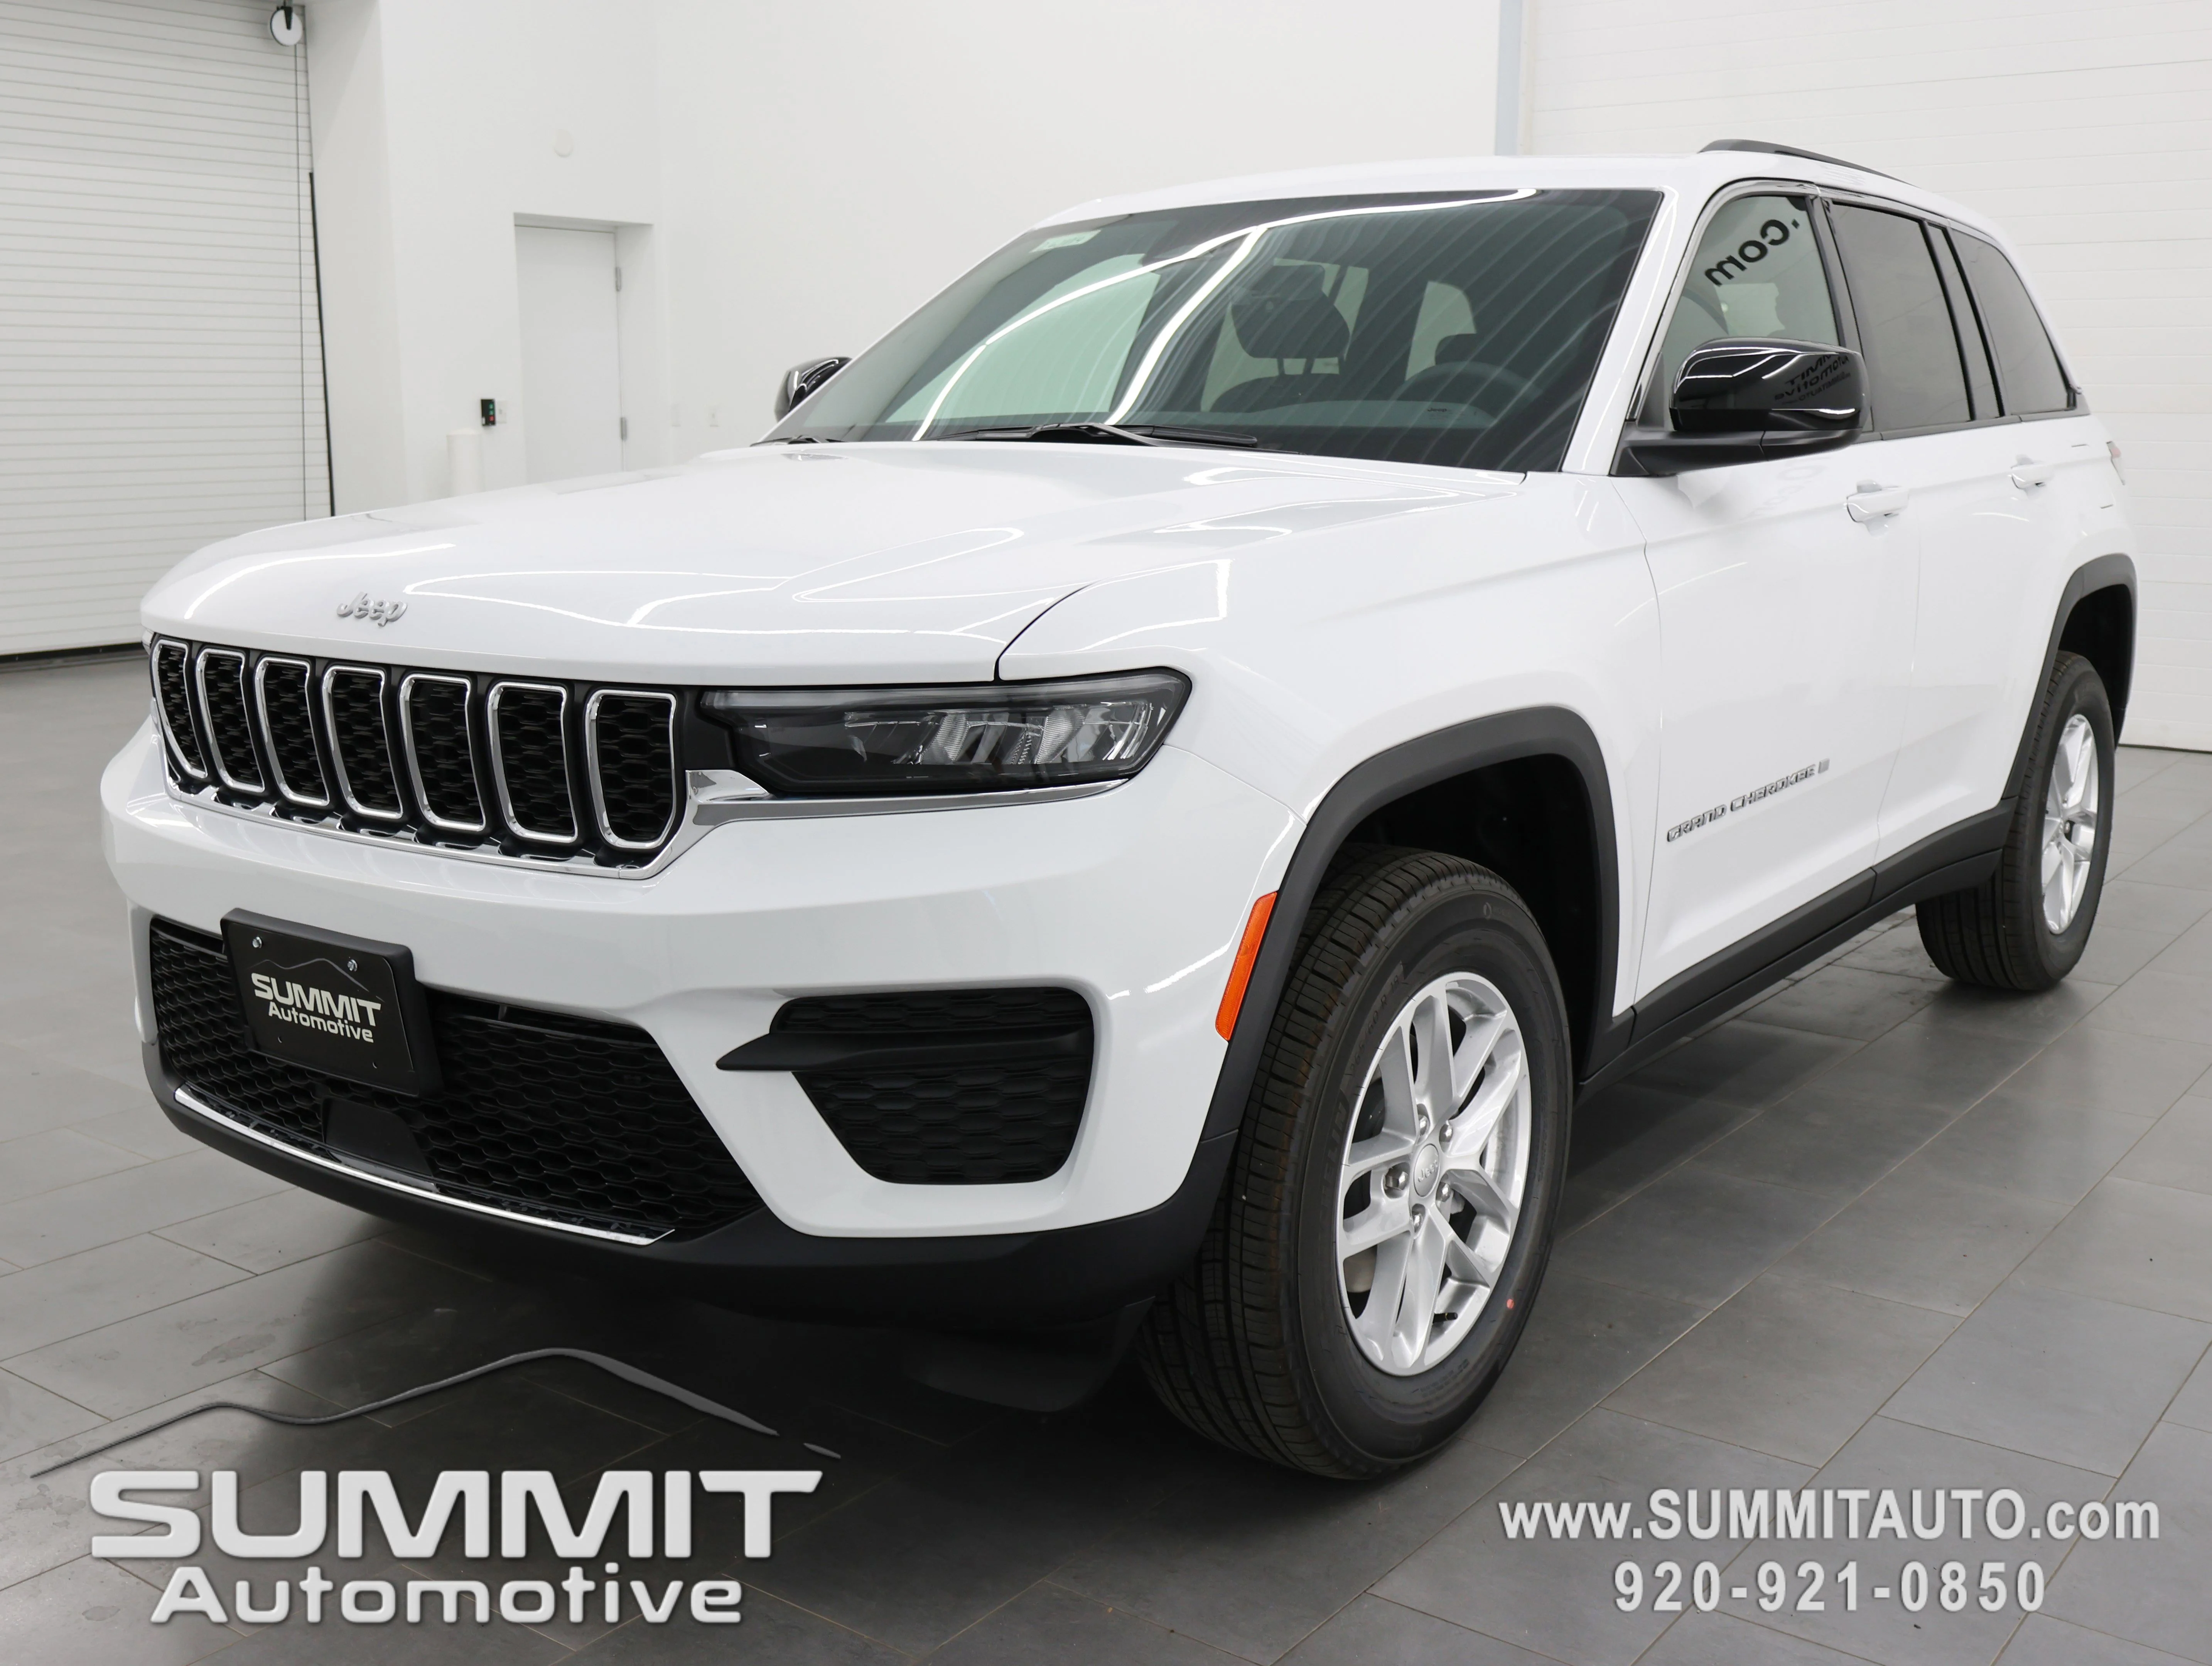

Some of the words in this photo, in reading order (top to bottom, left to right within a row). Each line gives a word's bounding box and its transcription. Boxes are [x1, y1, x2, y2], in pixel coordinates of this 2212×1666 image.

[337, 592, 408, 627] Jeep
[1667, 804, 1727, 842] GRAND
[1730, 764, 1815, 811] CHEROKEE
[251, 973, 381, 1026] SUMMIT
[268, 1002, 374, 1043] Automotive
[1418, 1159, 1438, 1182] Jeep
